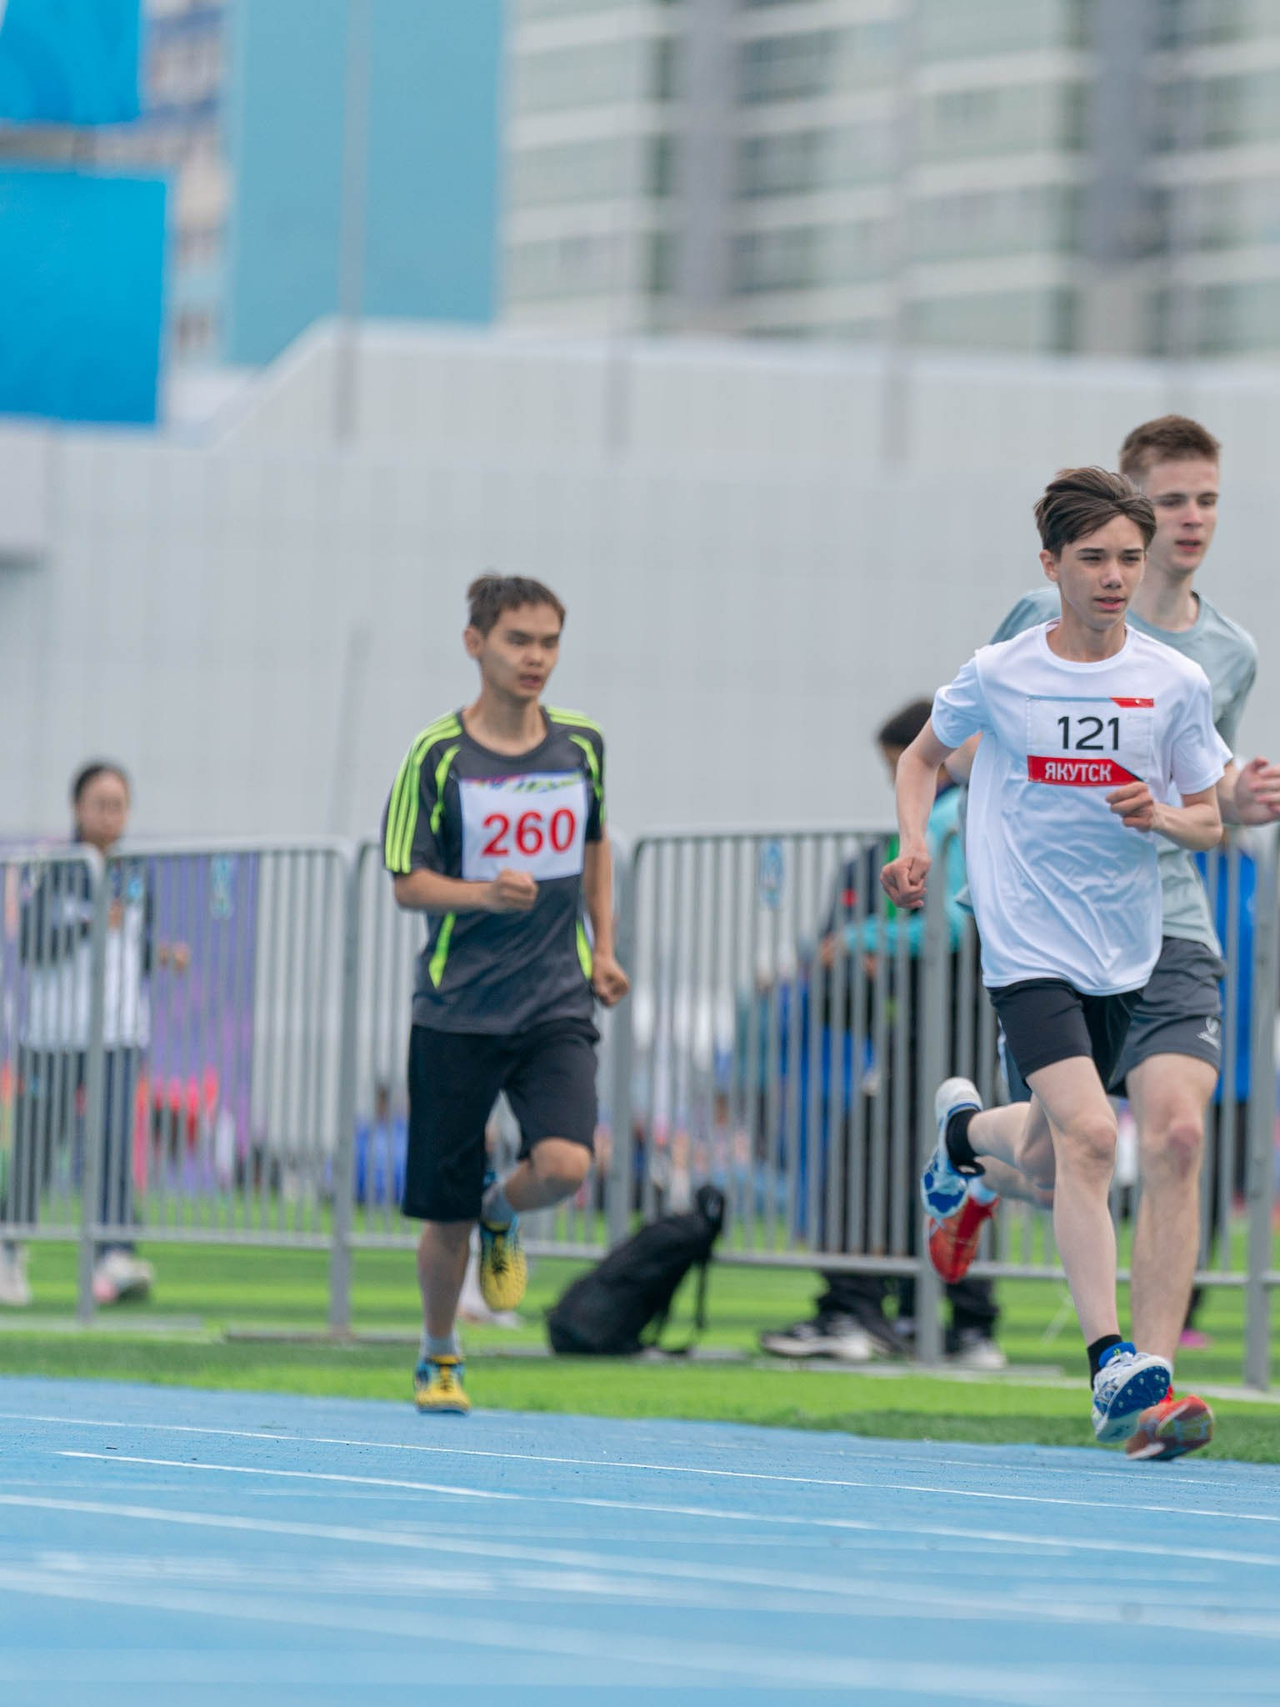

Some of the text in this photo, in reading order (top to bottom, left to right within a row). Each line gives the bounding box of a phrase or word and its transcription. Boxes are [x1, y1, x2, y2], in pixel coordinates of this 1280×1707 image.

[1058, 716, 1119, 750] 121
[1045, 762, 1112, 782] ЯКУТСК
[481, 807, 577, 857] 260
